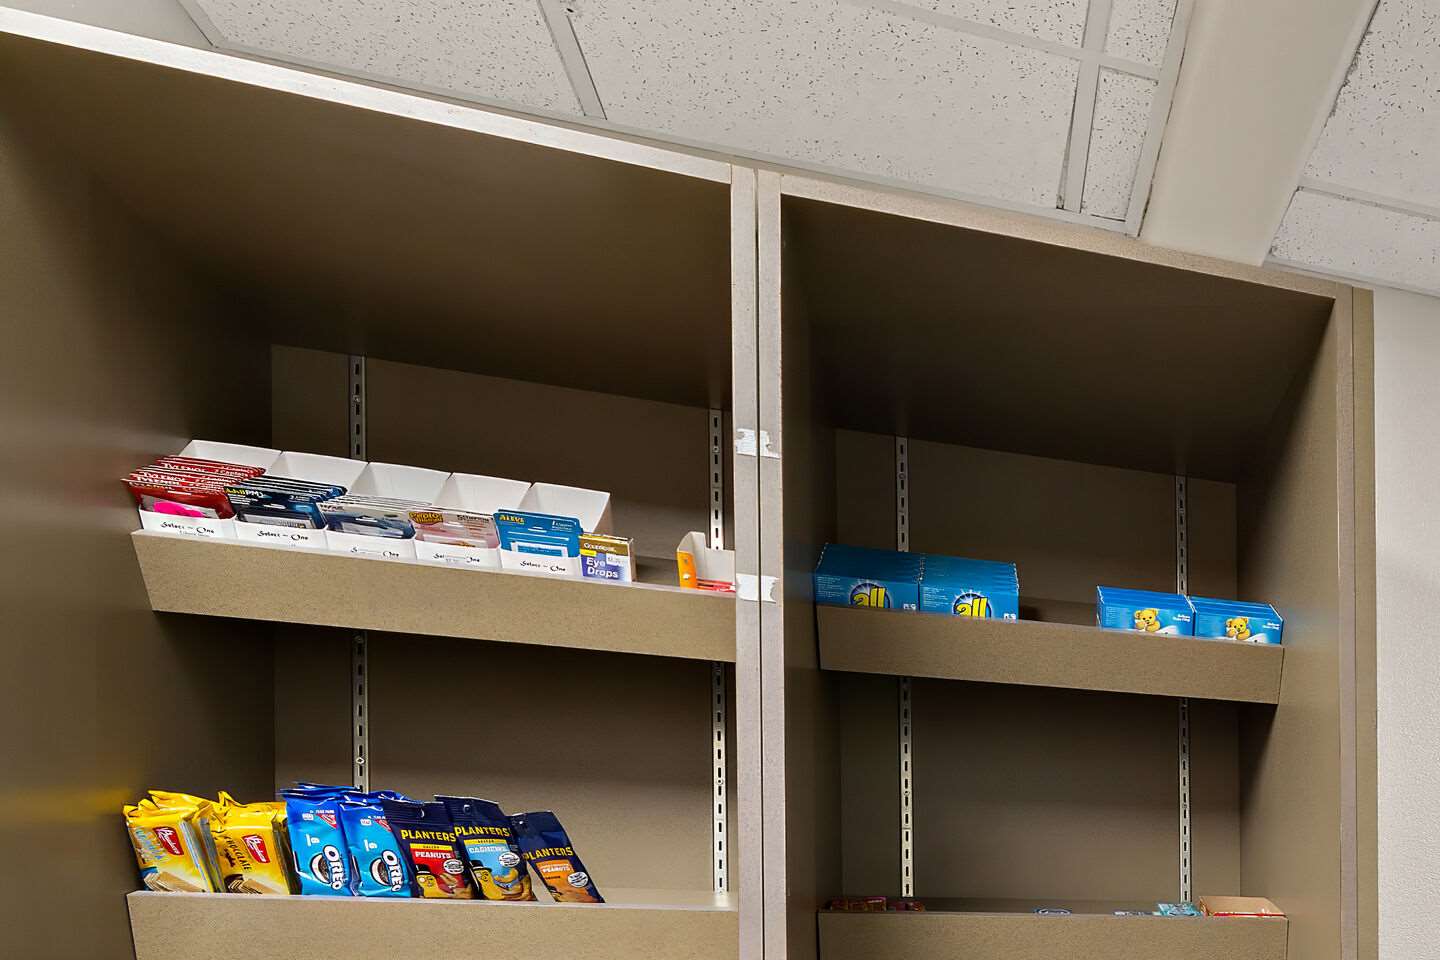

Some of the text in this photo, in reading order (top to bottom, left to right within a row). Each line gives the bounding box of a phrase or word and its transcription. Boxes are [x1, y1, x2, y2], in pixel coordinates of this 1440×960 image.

[586, 556, 606, 568] Eye
[587, 566, 619, 579] Drops
[853, 587, 887, 607] all
[956, 597, 989, 618] all
[401, 829, 457, 842] PLANTERS
[454, 826, 510, 838] PLANTERS
[415, 851, 451, 859] PEANUTS
[523, 847, 574, 861] PLANTERS
[323, 844, 346, 890] OREO
[382, 850, 403, 892] OREO
